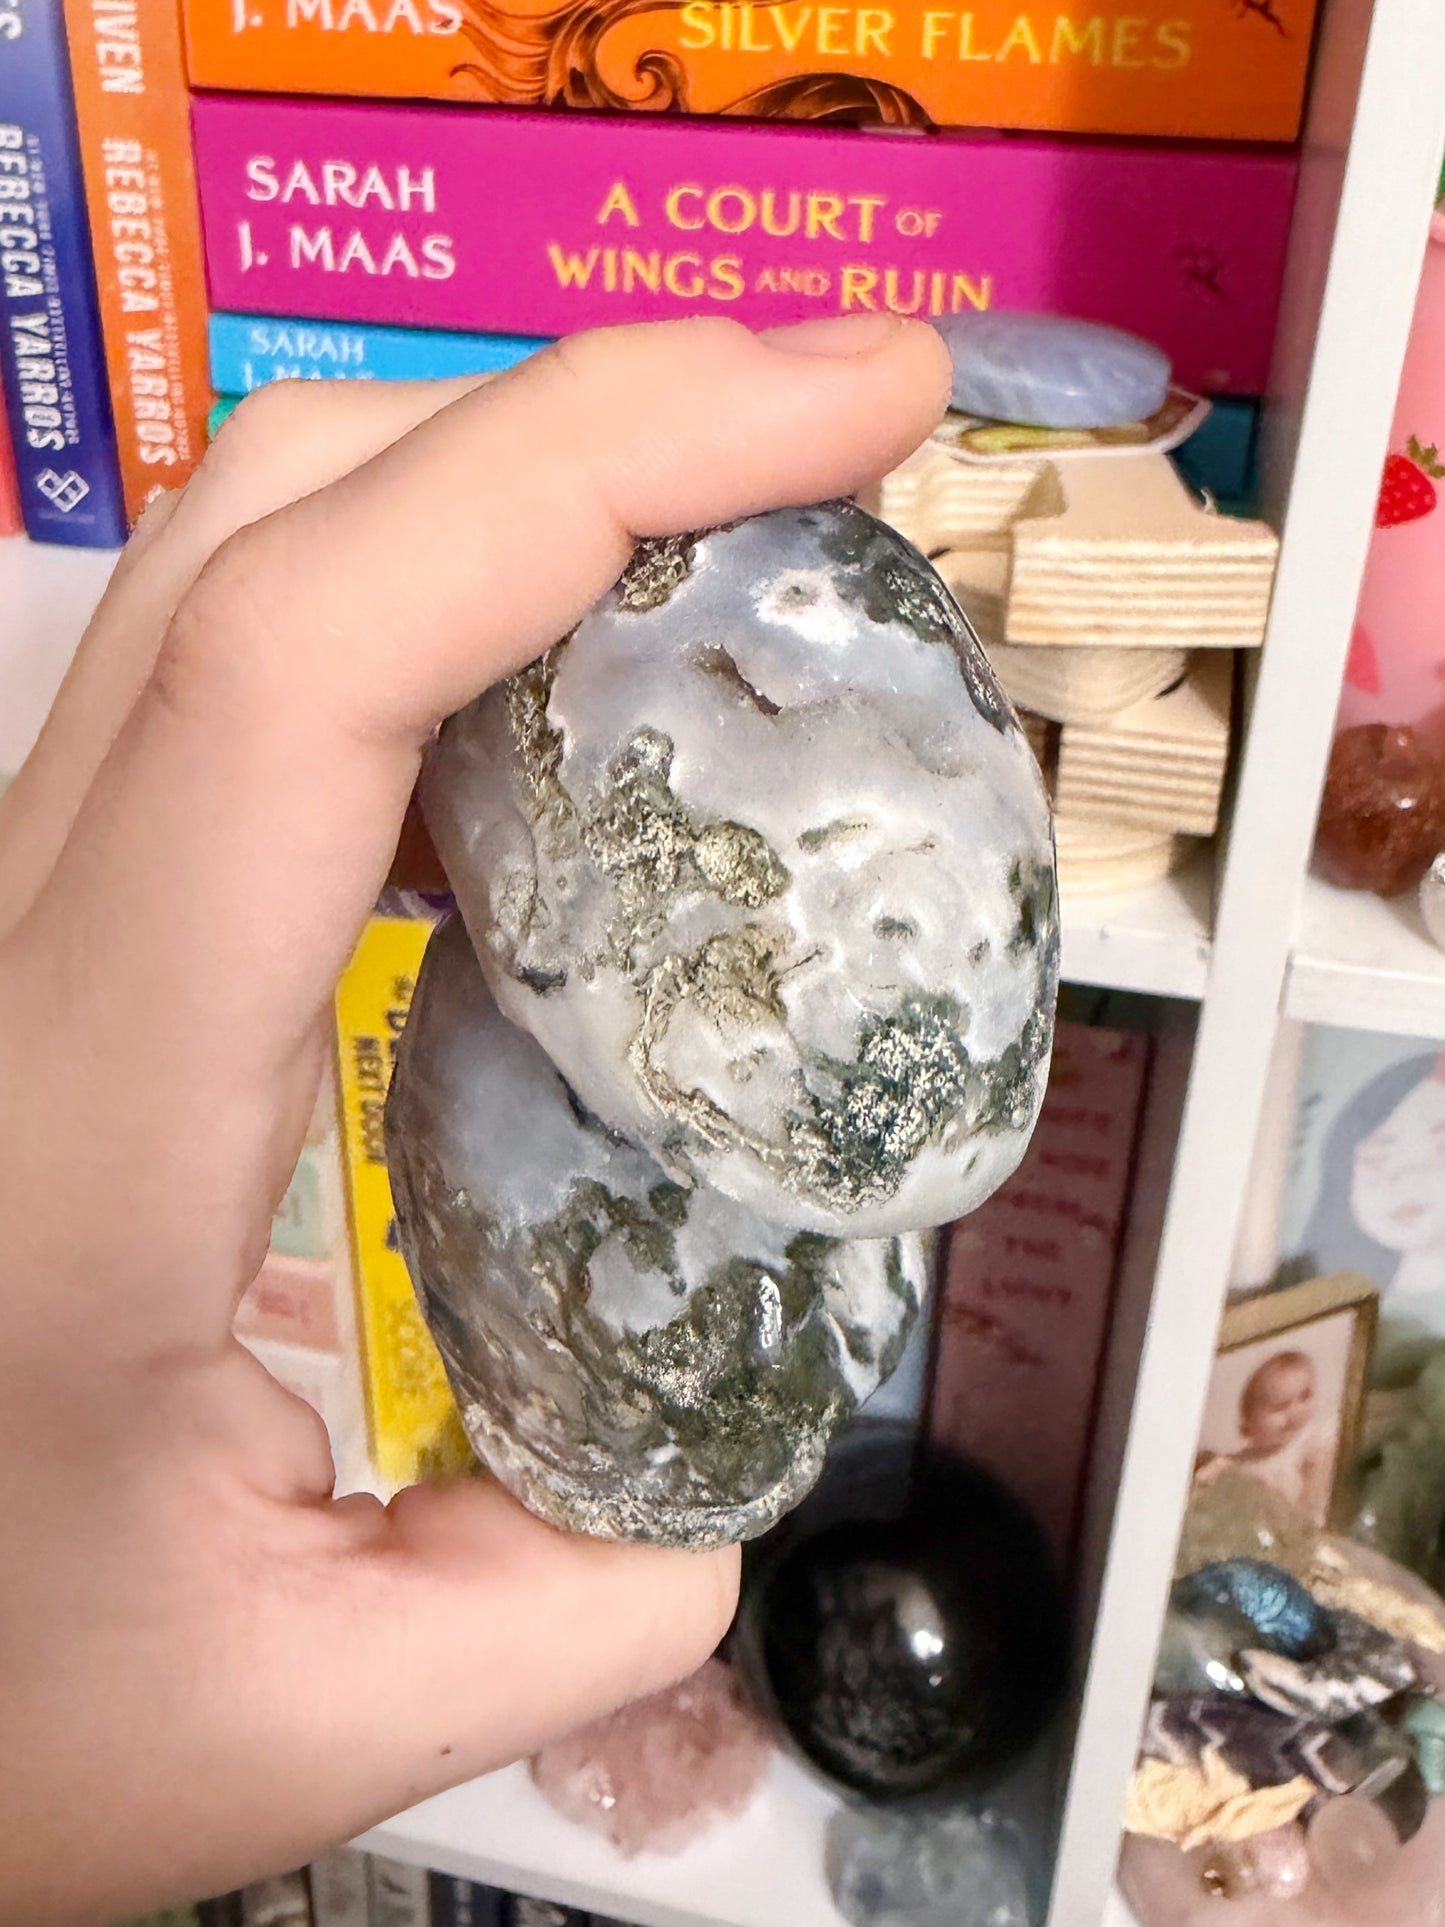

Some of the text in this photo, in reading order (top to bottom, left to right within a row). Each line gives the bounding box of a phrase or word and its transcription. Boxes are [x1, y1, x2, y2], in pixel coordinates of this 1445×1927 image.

[286, 0, 463, 36] MAAS
[679, 0, 1193, 69] SILVER FLAMES
[0, 123, 45, 297] REBECCA
[246, 155, 437, 213] SARAH
[597, 182, 942, 243] A COURT OF
[101, 138, 159, 313] REBECCA
[237, 220, 457, 281] J. MAAS
[547, 243, 992, 314] WINGS AND RUIN
[250, 323, 366, 366] SARAH
[9, 312, 64, 451] YARROS
[125, 331, 178, 467] YARROS
